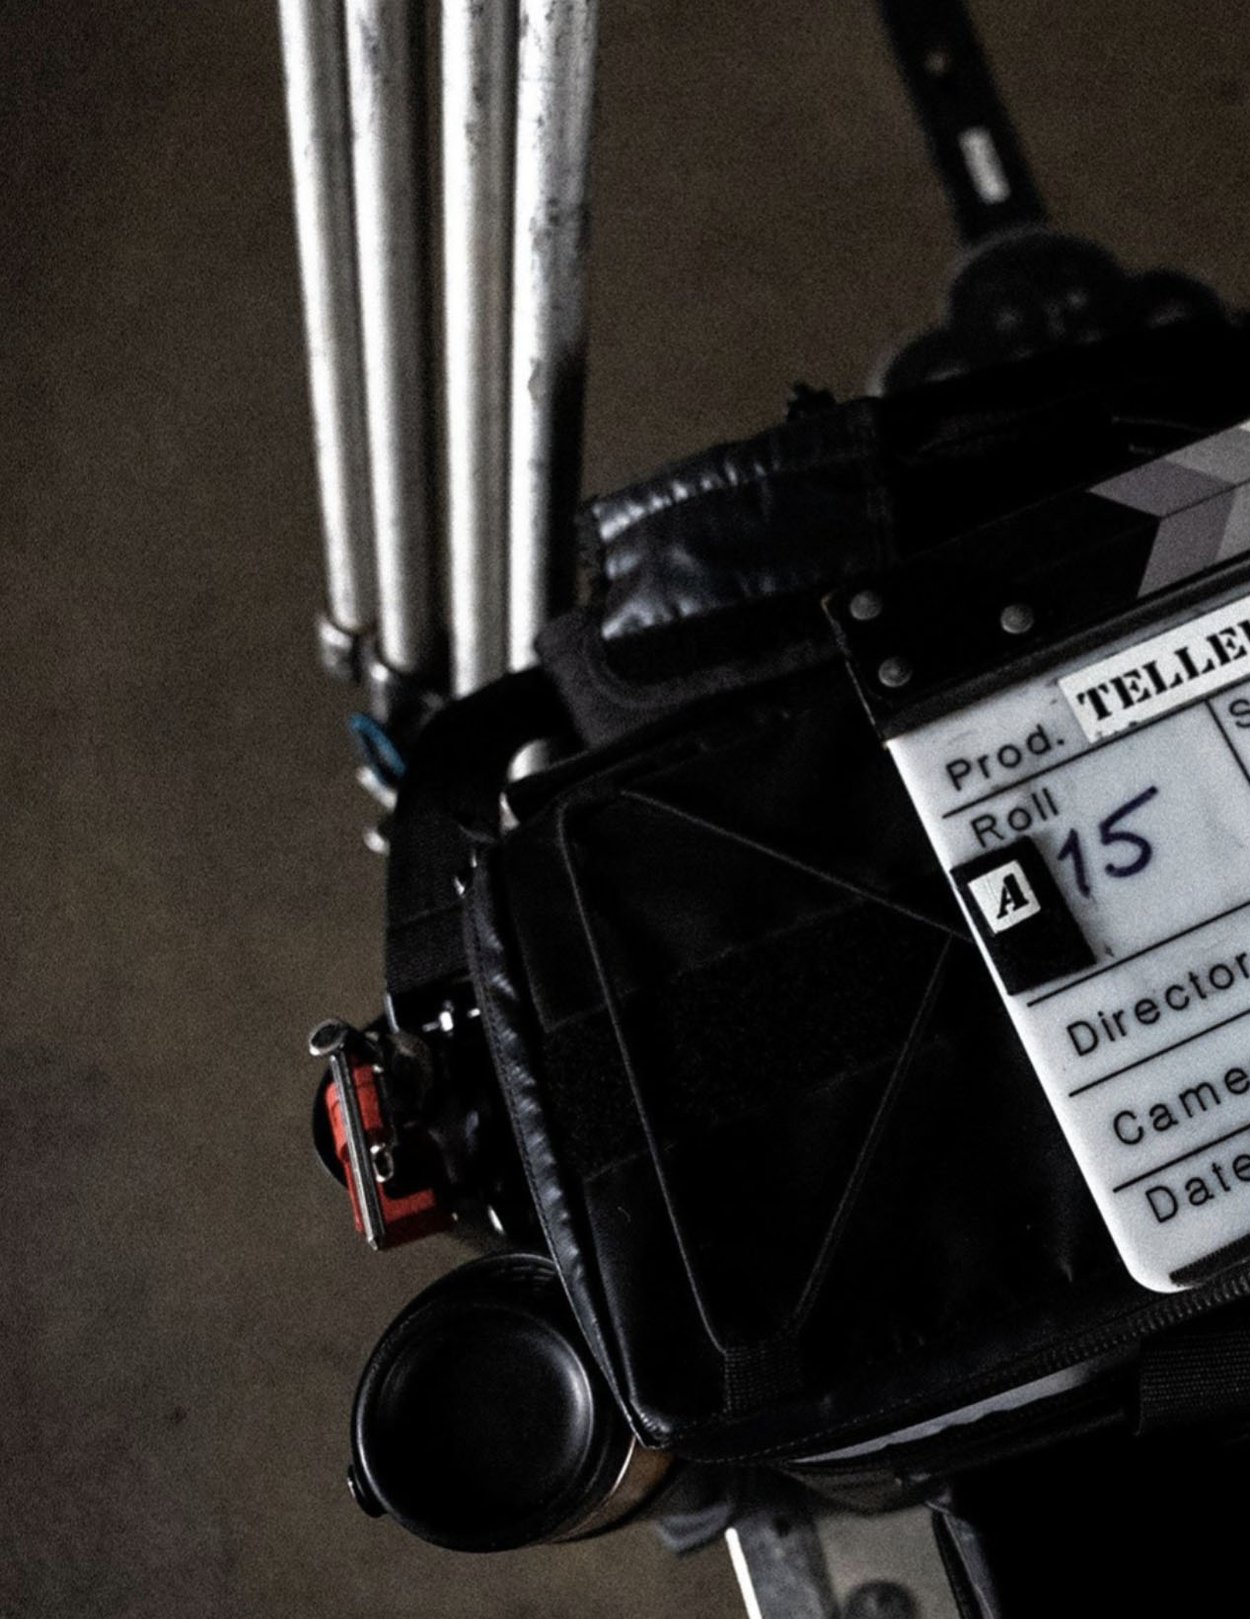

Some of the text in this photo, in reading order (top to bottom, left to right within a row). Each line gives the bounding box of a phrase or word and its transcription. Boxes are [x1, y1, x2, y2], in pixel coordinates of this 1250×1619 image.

[945, 723, 1065, 792] Prod.
[970, 787, 1061, 848] Roll
[1057, 786, 1158, 898] 15
[995, 873, 1030, 920] A
[1067, 952, 1250, 1057] Director
